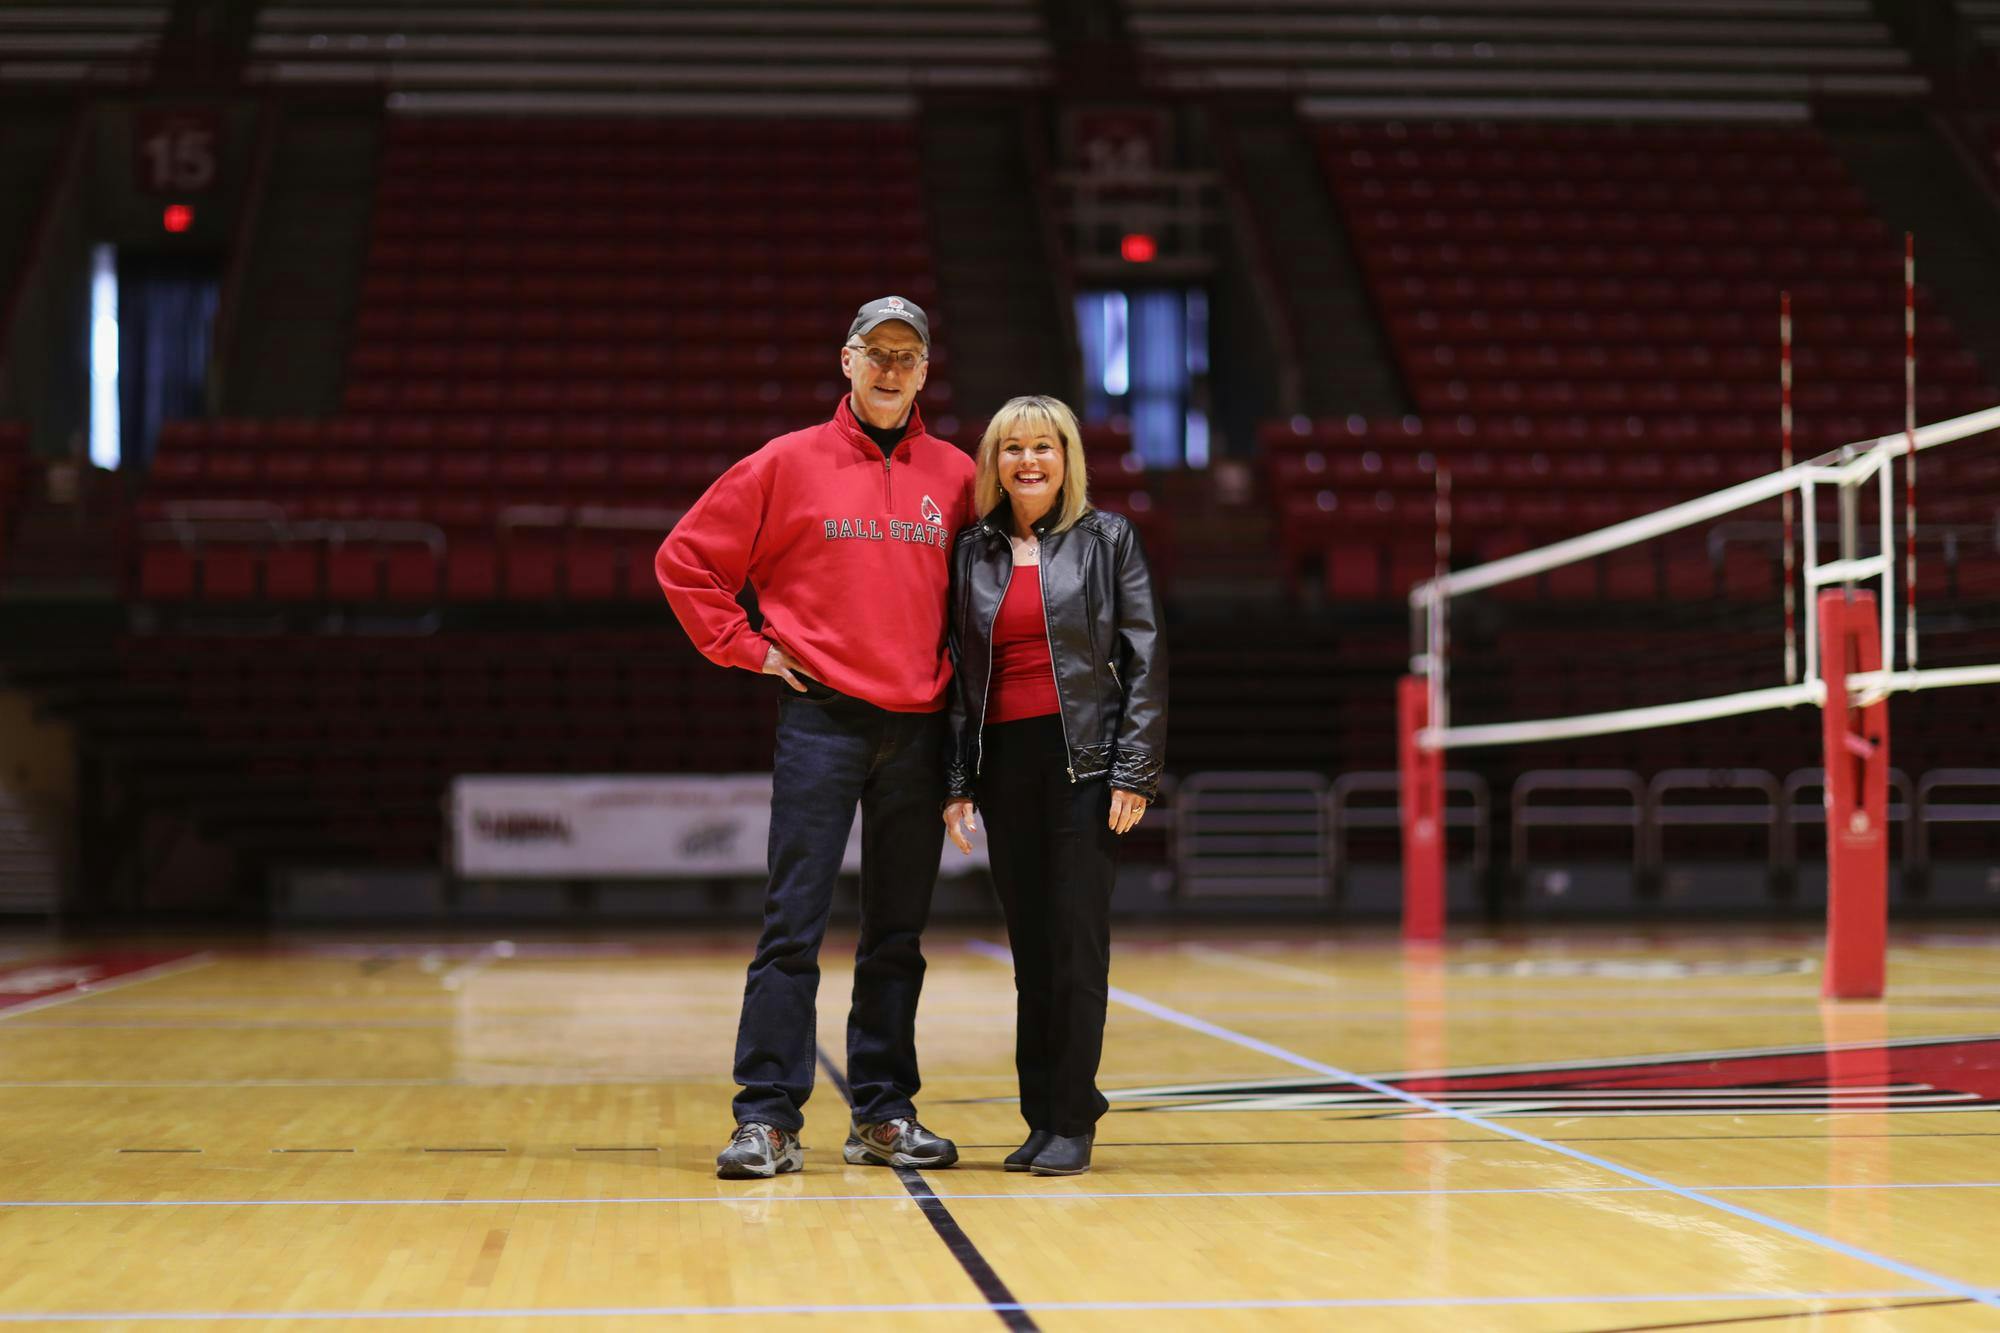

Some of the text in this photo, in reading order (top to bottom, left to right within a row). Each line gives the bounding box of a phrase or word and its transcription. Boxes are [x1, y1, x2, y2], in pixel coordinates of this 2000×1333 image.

[146, 130, 216, 190] 15
[824, 519, 949, 549] BALL STATE
